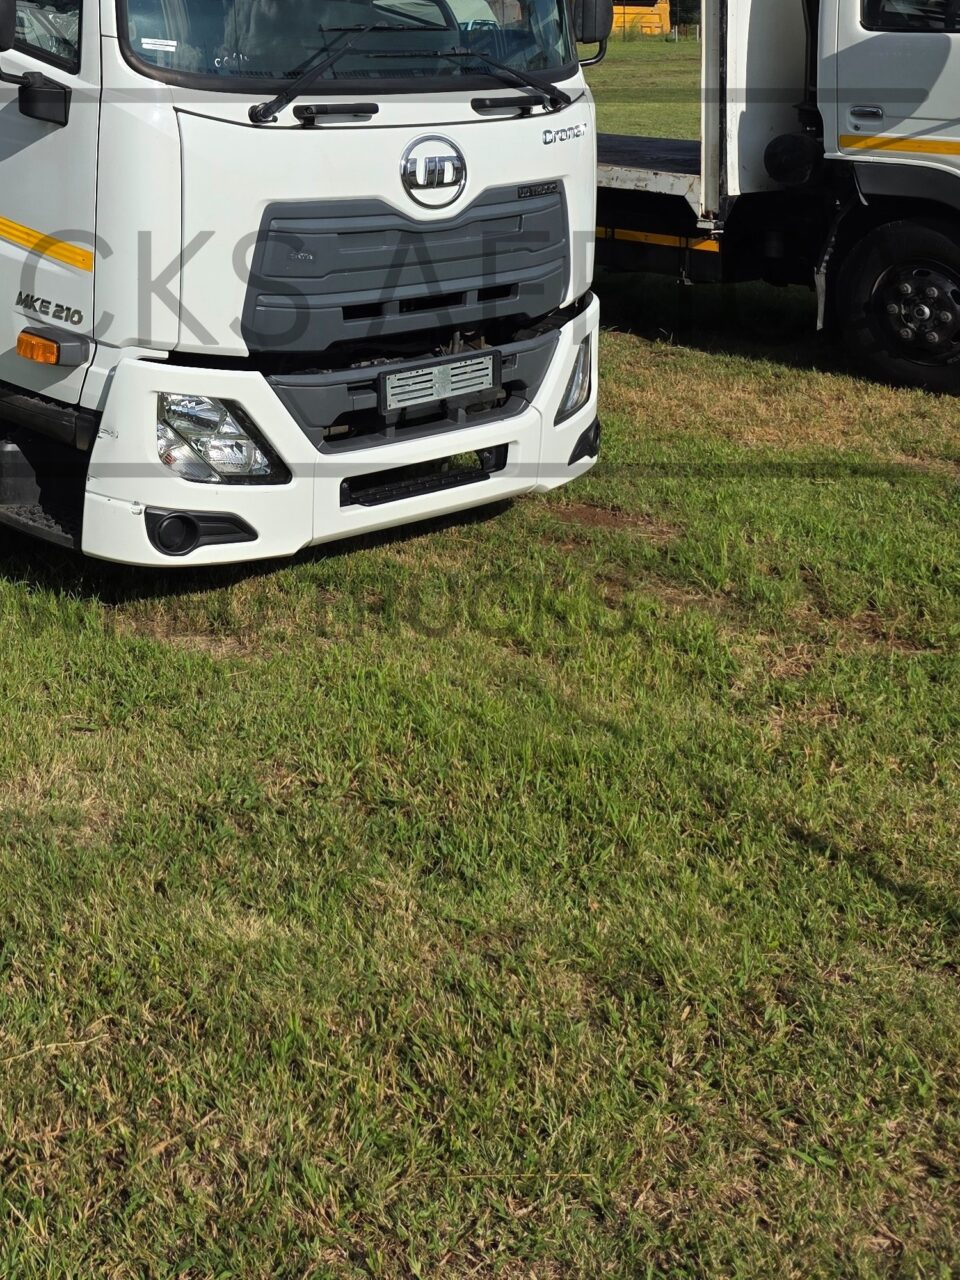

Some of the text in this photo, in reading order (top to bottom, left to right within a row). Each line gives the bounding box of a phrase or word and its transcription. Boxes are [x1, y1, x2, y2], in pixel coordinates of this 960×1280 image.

[406, 156, 463, 189] UD
[15, 290, 84, 326] MKE 210
